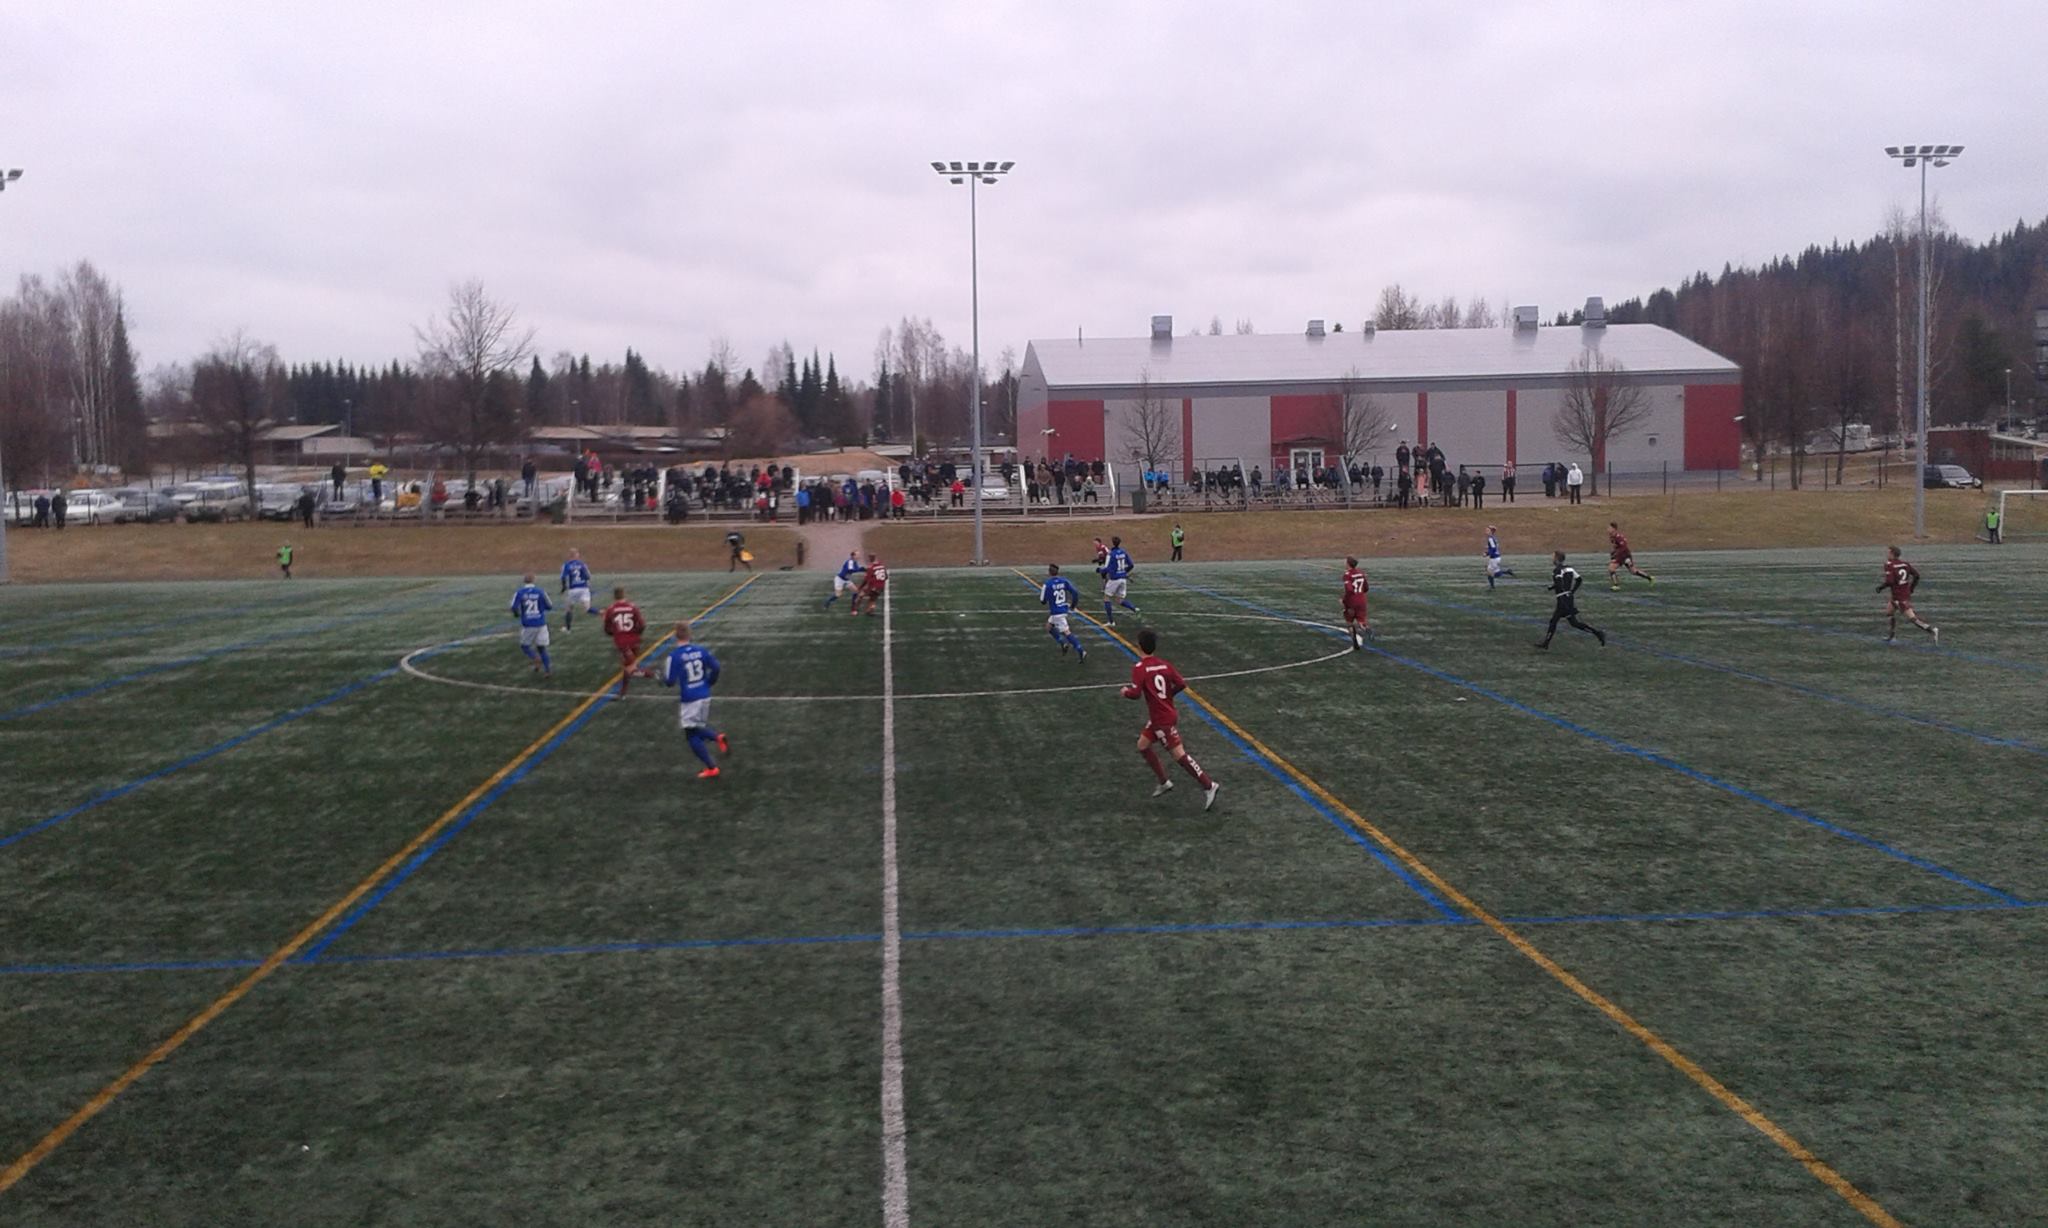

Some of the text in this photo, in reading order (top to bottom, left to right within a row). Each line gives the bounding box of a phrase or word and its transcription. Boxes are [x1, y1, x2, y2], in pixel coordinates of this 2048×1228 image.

[1899, 569, 1908, 585] 2
[1353, 579, 1365, 592] 17
[1054, 590, 1066, 604] 29
[526, 600, 540, 614] 21
[614, 613, 634, 631] 15
[686, 661, 704, 681] 13
[1155, 674, 1167, 699] 9
